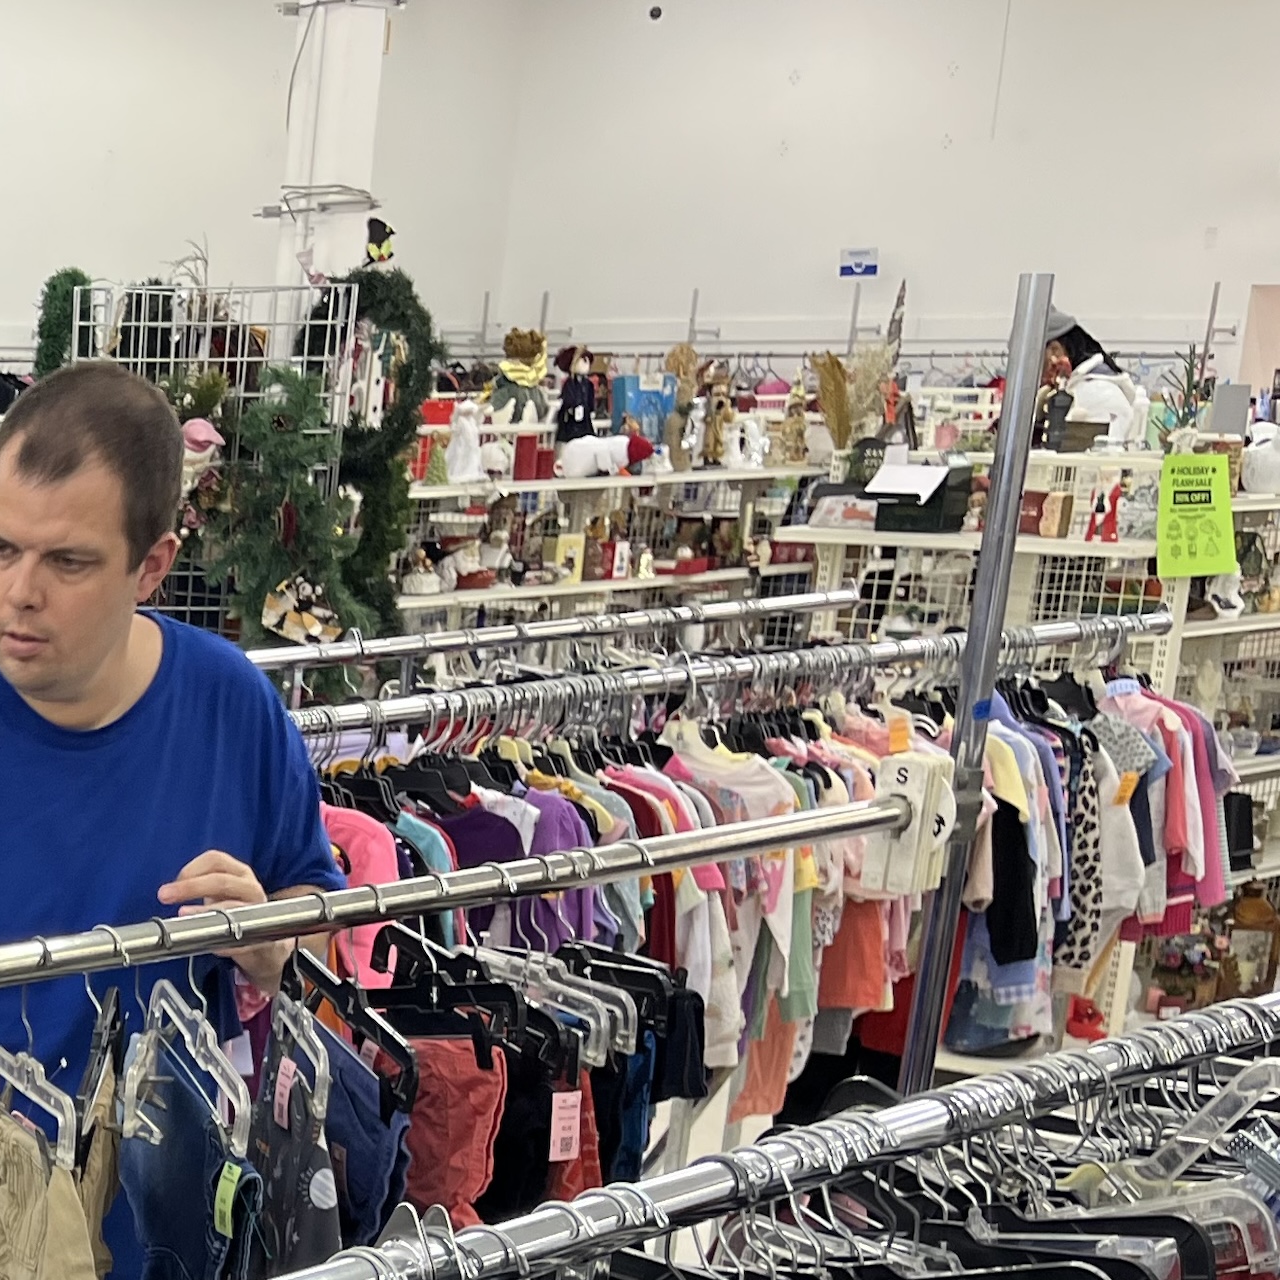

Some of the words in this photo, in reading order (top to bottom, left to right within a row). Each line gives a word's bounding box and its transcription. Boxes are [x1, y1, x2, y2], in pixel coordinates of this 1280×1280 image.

[1176, 465, 1210, 476] HOLIDAY
[1172, 478, 1195, 487] FLASH
[1195, 477, 1212, 487] SALE
[896, 767, 909, 784] S
